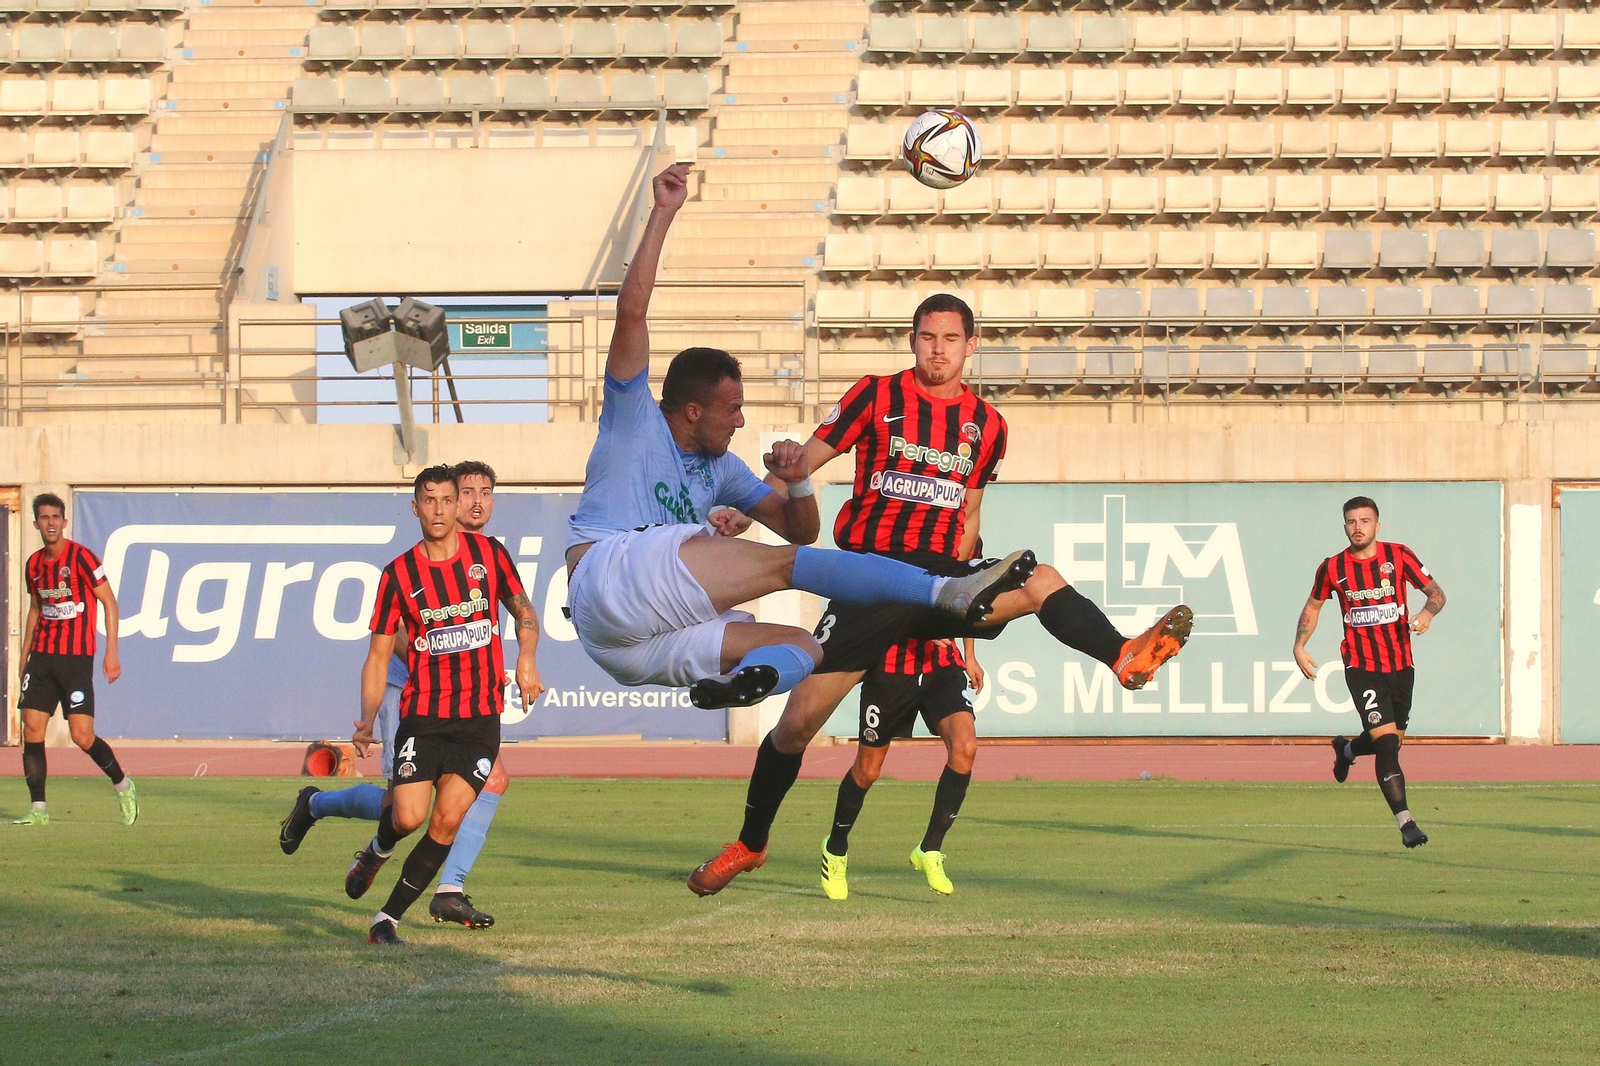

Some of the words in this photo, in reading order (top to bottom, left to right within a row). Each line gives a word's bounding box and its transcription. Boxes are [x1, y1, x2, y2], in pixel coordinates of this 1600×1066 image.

[465, 323, 507, 334] Salida
[477, 335, 495, 345] Exit
[889, 435, 974, 476] Peregrin
[1345, 578, 1395, 601] Peregrin
[420, 588, 488, 625] Peregrin
[814, 614, 837, 645] 3
[21, 673, 31, 691] 8
[543, 685, 693, 708] Aniversario
[1362, 689, 1379, 711] 2
[865, 704, 881, 729] 6
[398, 736, 416, 761] 4
